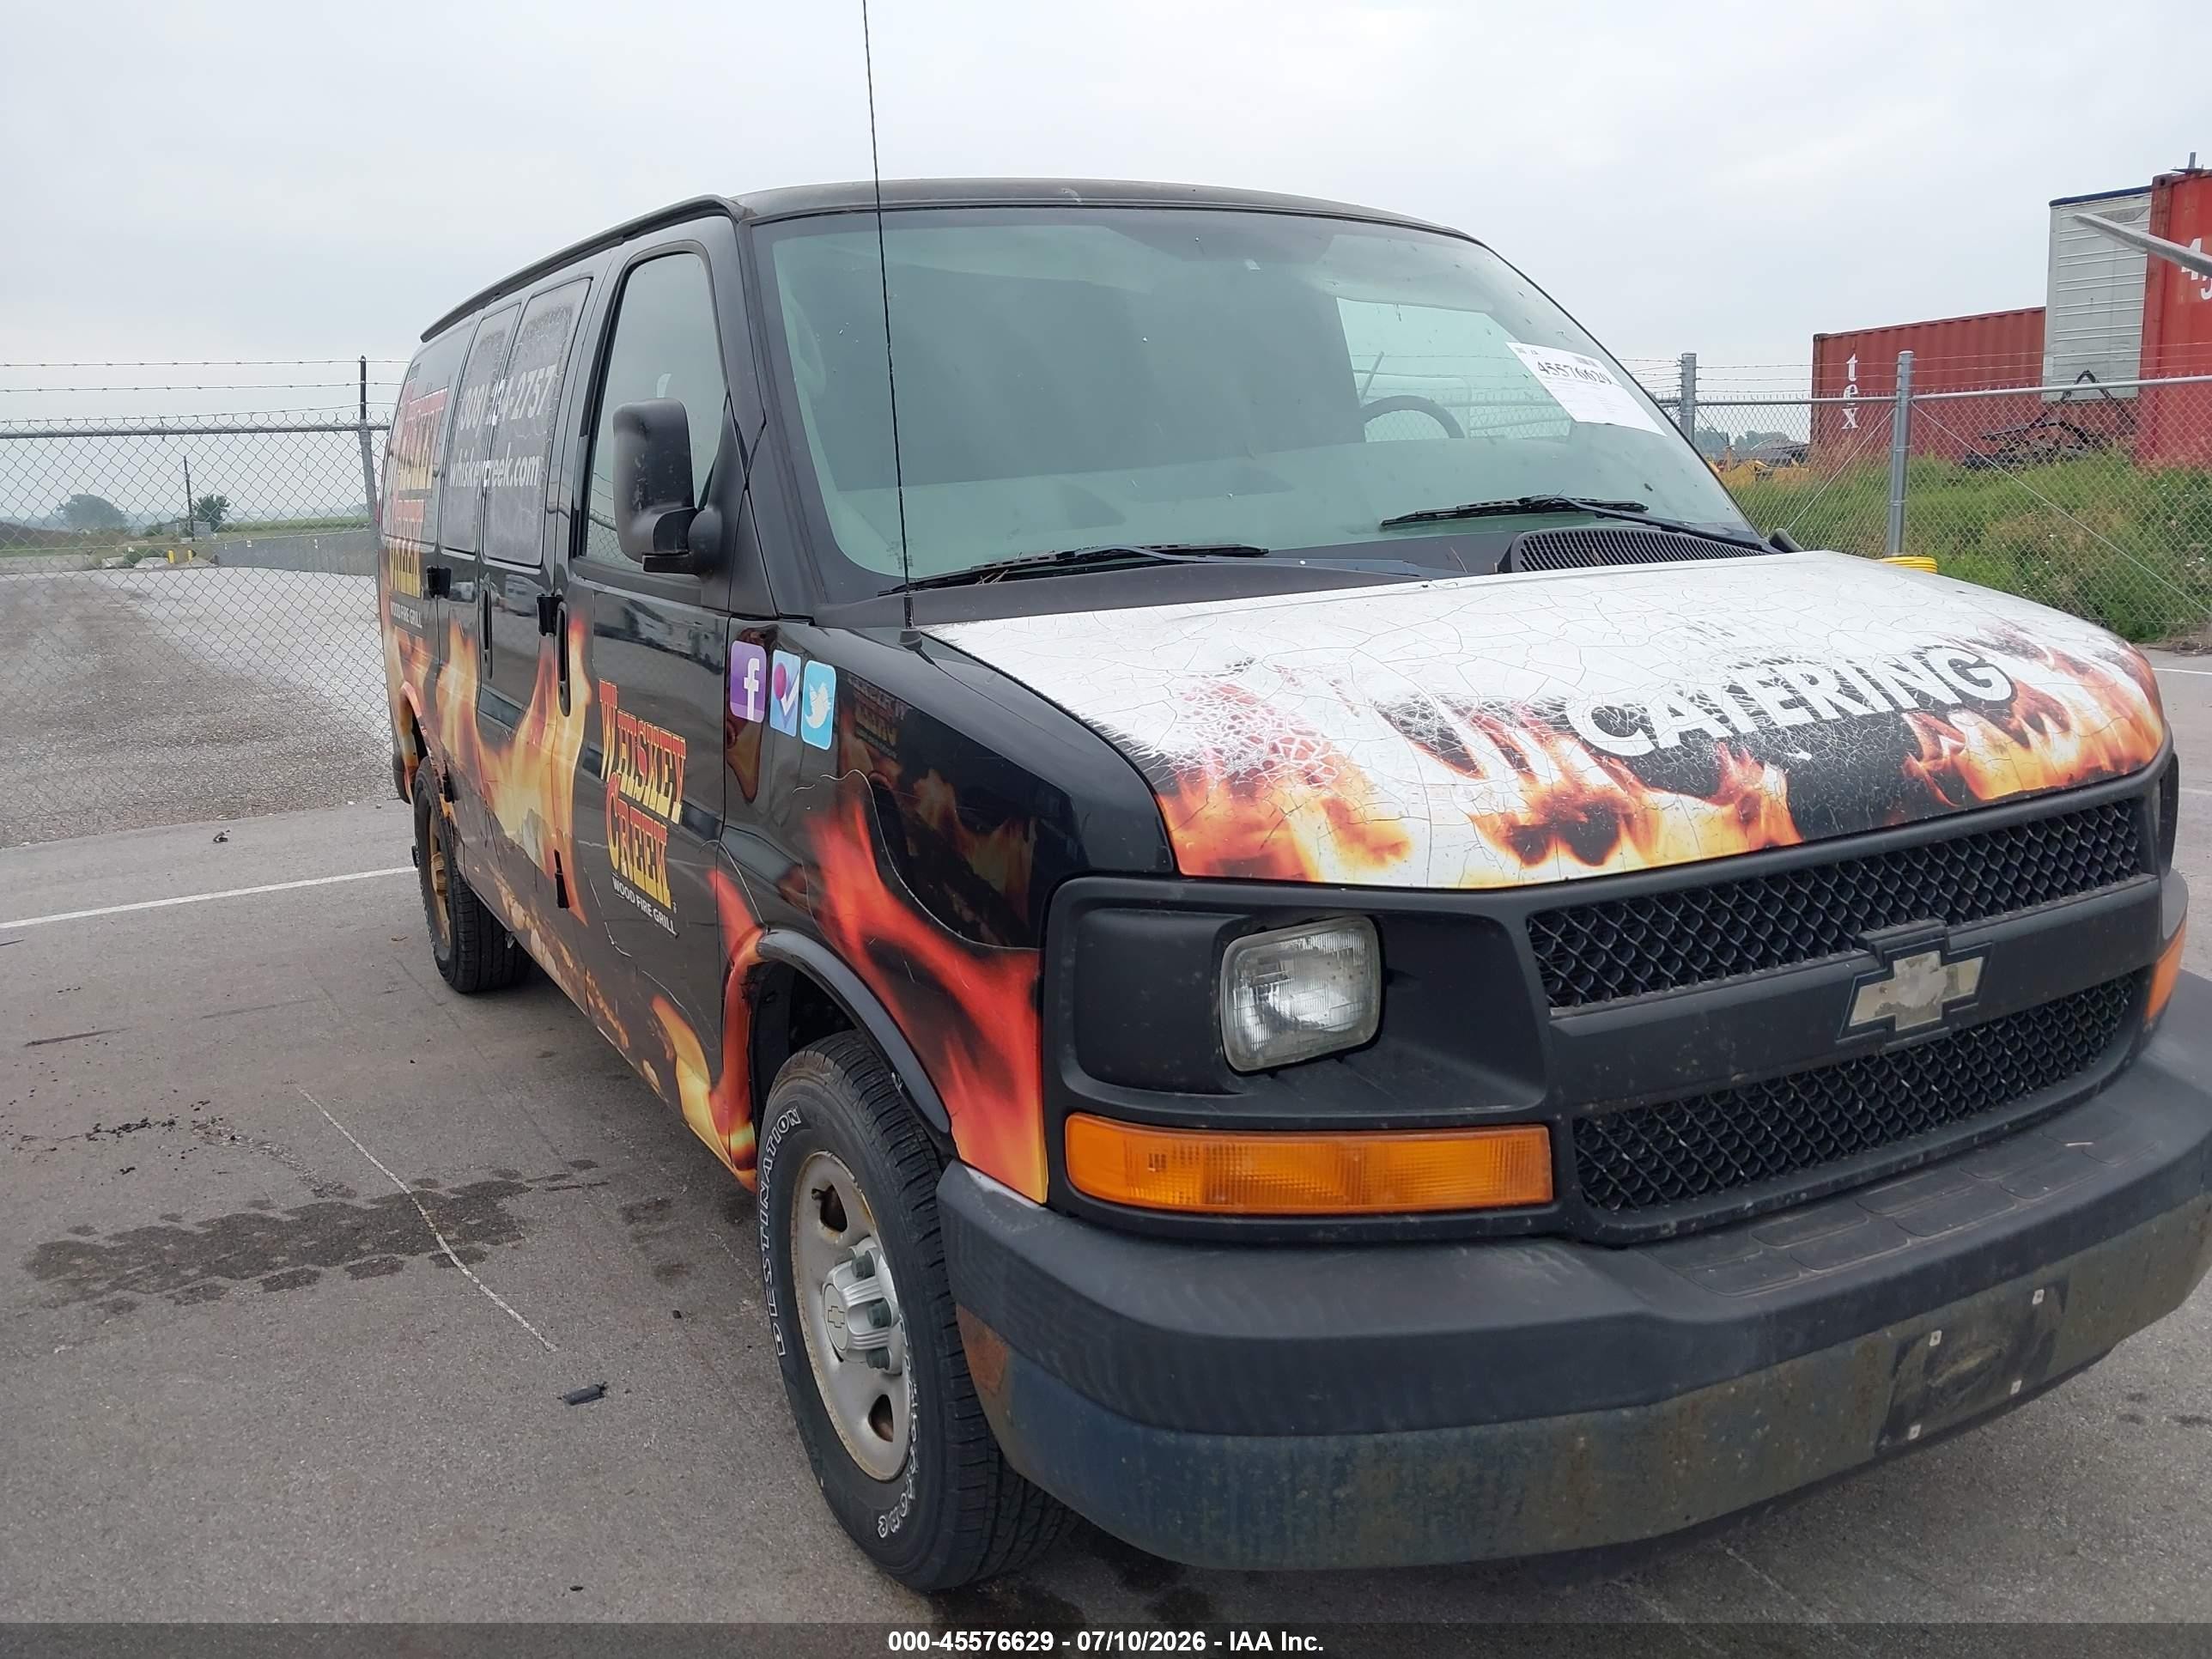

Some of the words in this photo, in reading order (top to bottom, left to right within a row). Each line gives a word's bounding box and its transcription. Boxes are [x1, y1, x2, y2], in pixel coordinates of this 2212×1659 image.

[1538, 361, 1613, 384] 45576629
[599, 678, 687, 825] WHISKEY
[1566, 645, 2012, 757] CATERING
[605, 773, 672, 910] CREEK
[611, 876, 635, 903] WOOD
[635, 894, 653, 918] FIRE
[653, 908, 678, 935] GRILL
[758, 1105, 802, 1357] DESTINATION
